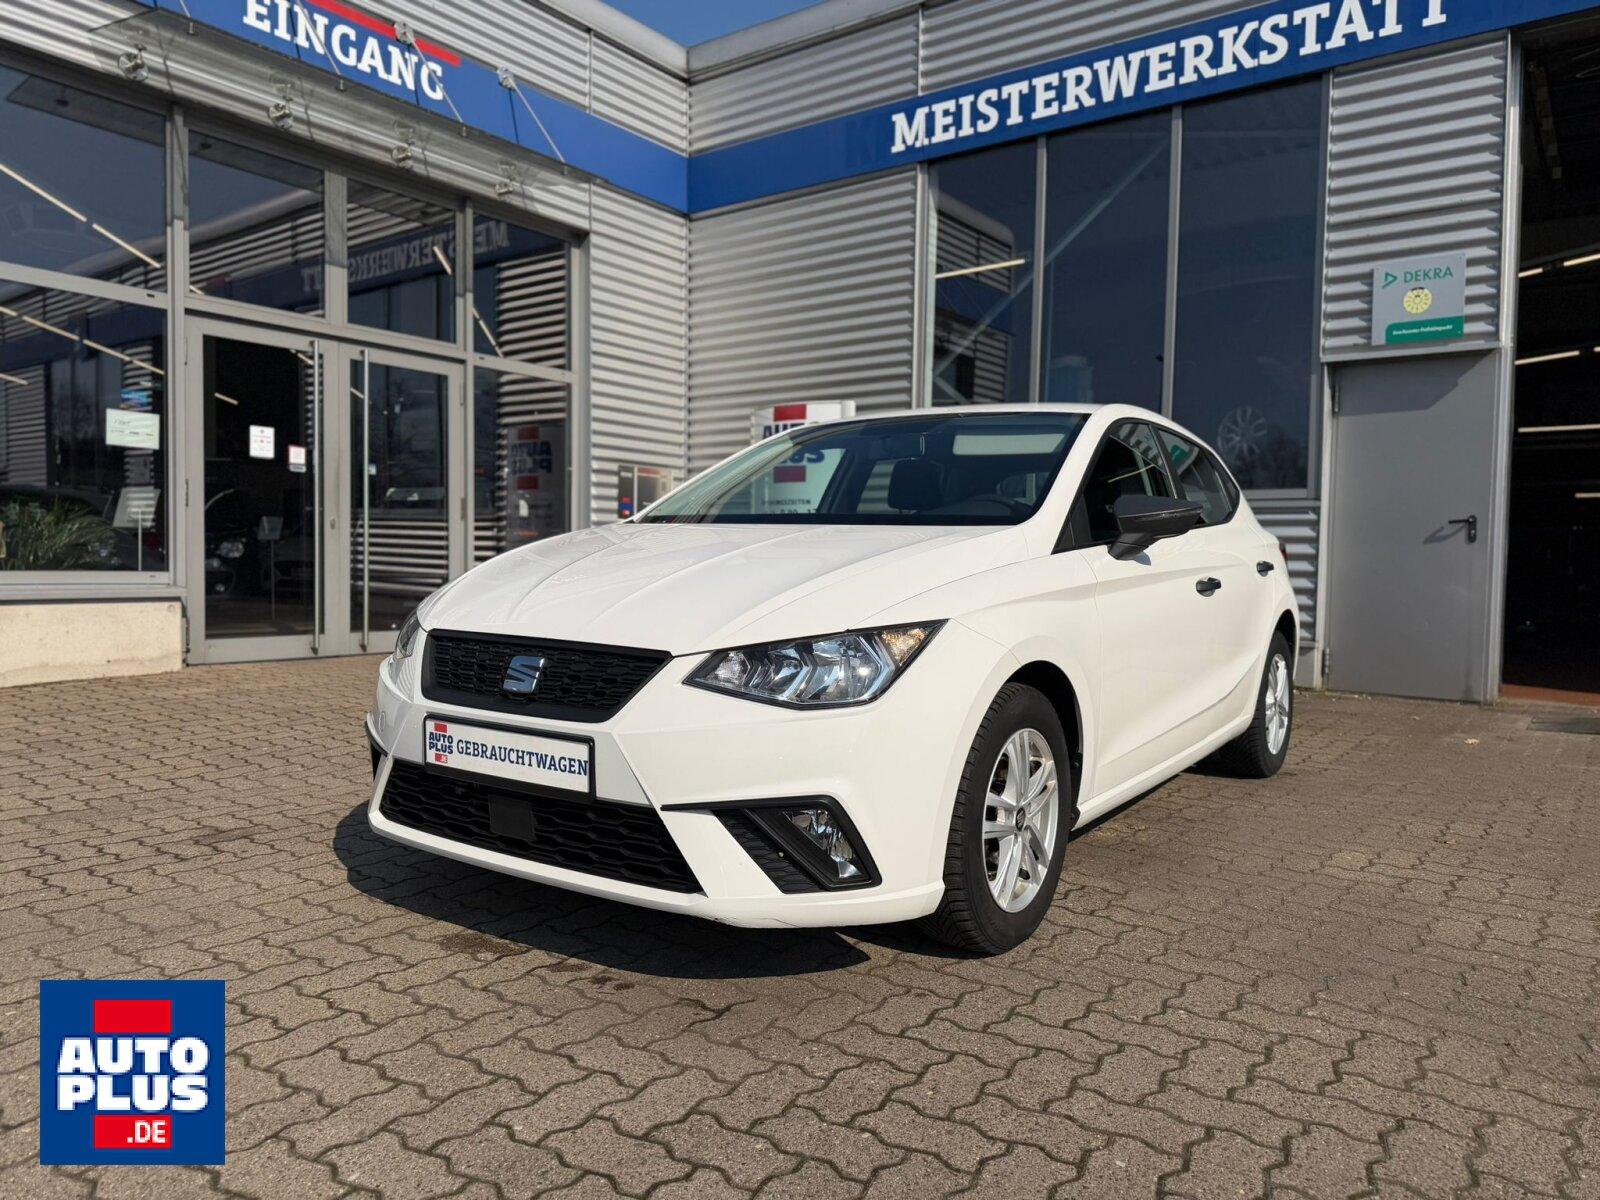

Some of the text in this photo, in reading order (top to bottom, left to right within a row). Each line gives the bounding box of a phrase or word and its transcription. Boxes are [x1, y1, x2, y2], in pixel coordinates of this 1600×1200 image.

[243, 0, 444, 101] EINGANG
[890, 0, 1447, 154] MEISTERWERKSTATT
[1404, 266, 1453, 283] DEKRA
[429, 732, 454, 744] AUTO
[429, 741, 454, 755] PLUS
[457, 739, 589, 776] GEBRAUCHTWAGEN
